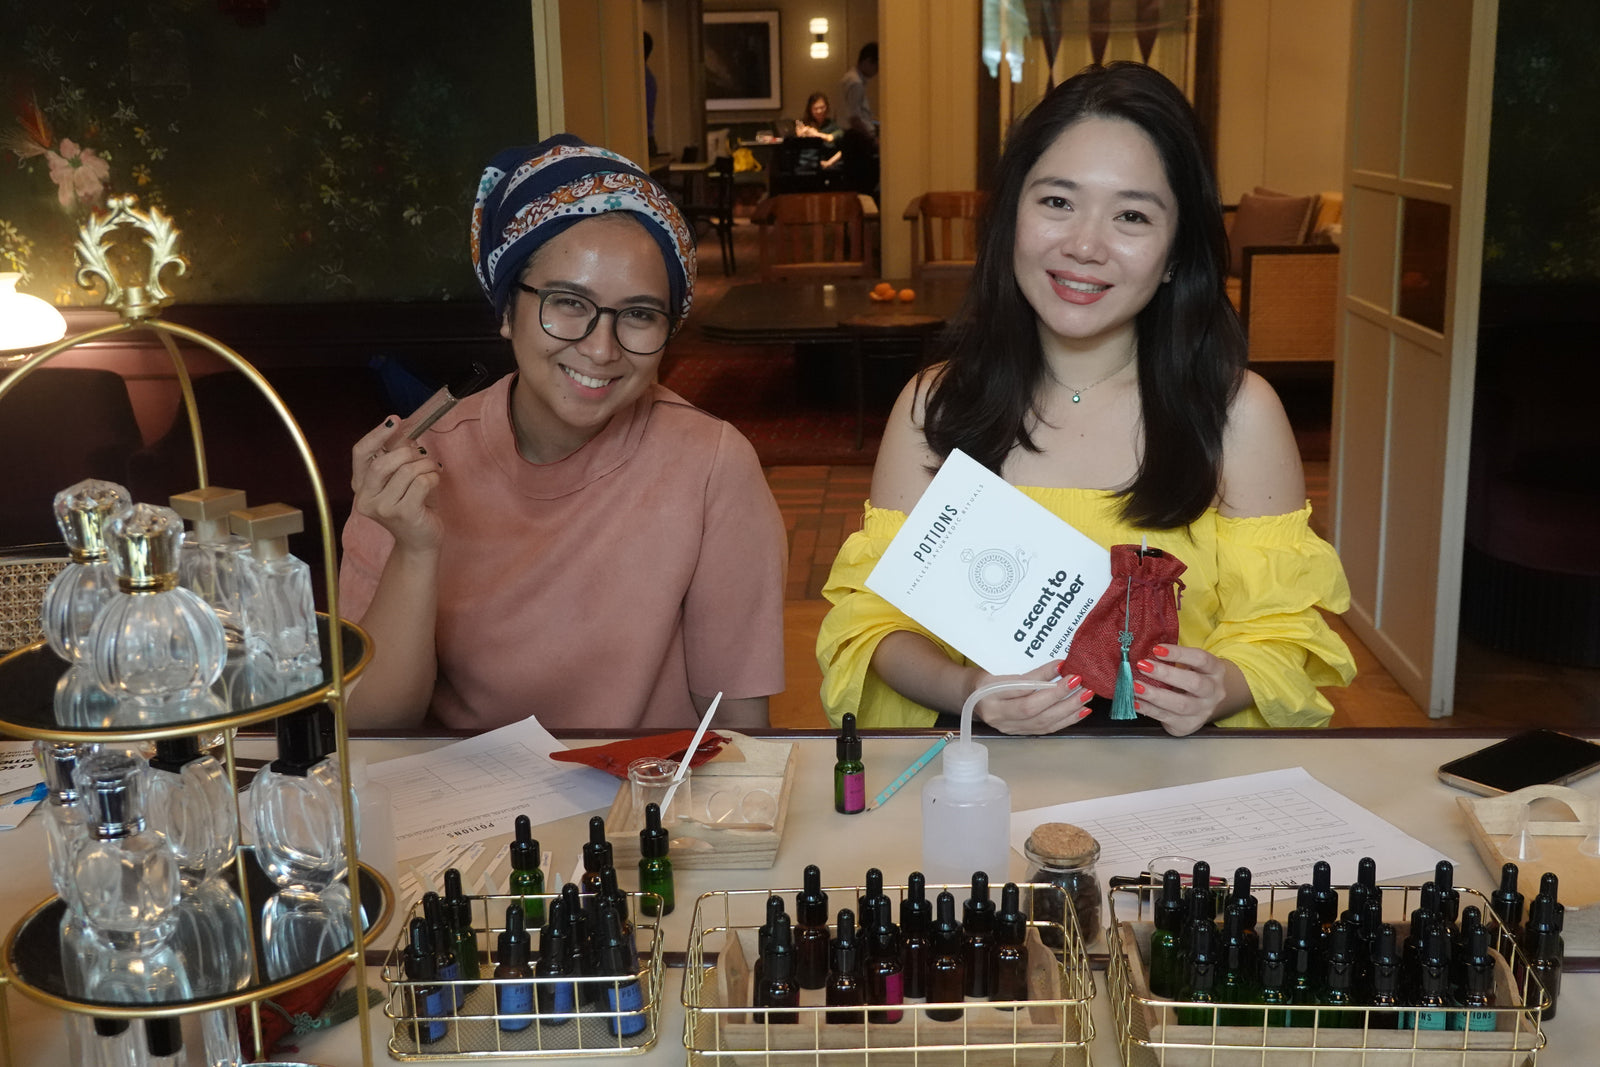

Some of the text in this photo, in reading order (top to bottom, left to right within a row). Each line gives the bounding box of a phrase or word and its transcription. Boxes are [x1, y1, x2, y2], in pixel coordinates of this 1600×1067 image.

[906, 484, 984, 595] TIMELESS AYURVEDIC RITUALS
[913, 504, 957, 562] POTIONS
[1013, 570, 1067, 642] a scent to
[1024, 573, 1084, 659] remember
[1049, 597, 1094, 658] PERFUME MAKING
[446, 822, 495, 839] POTIONS
